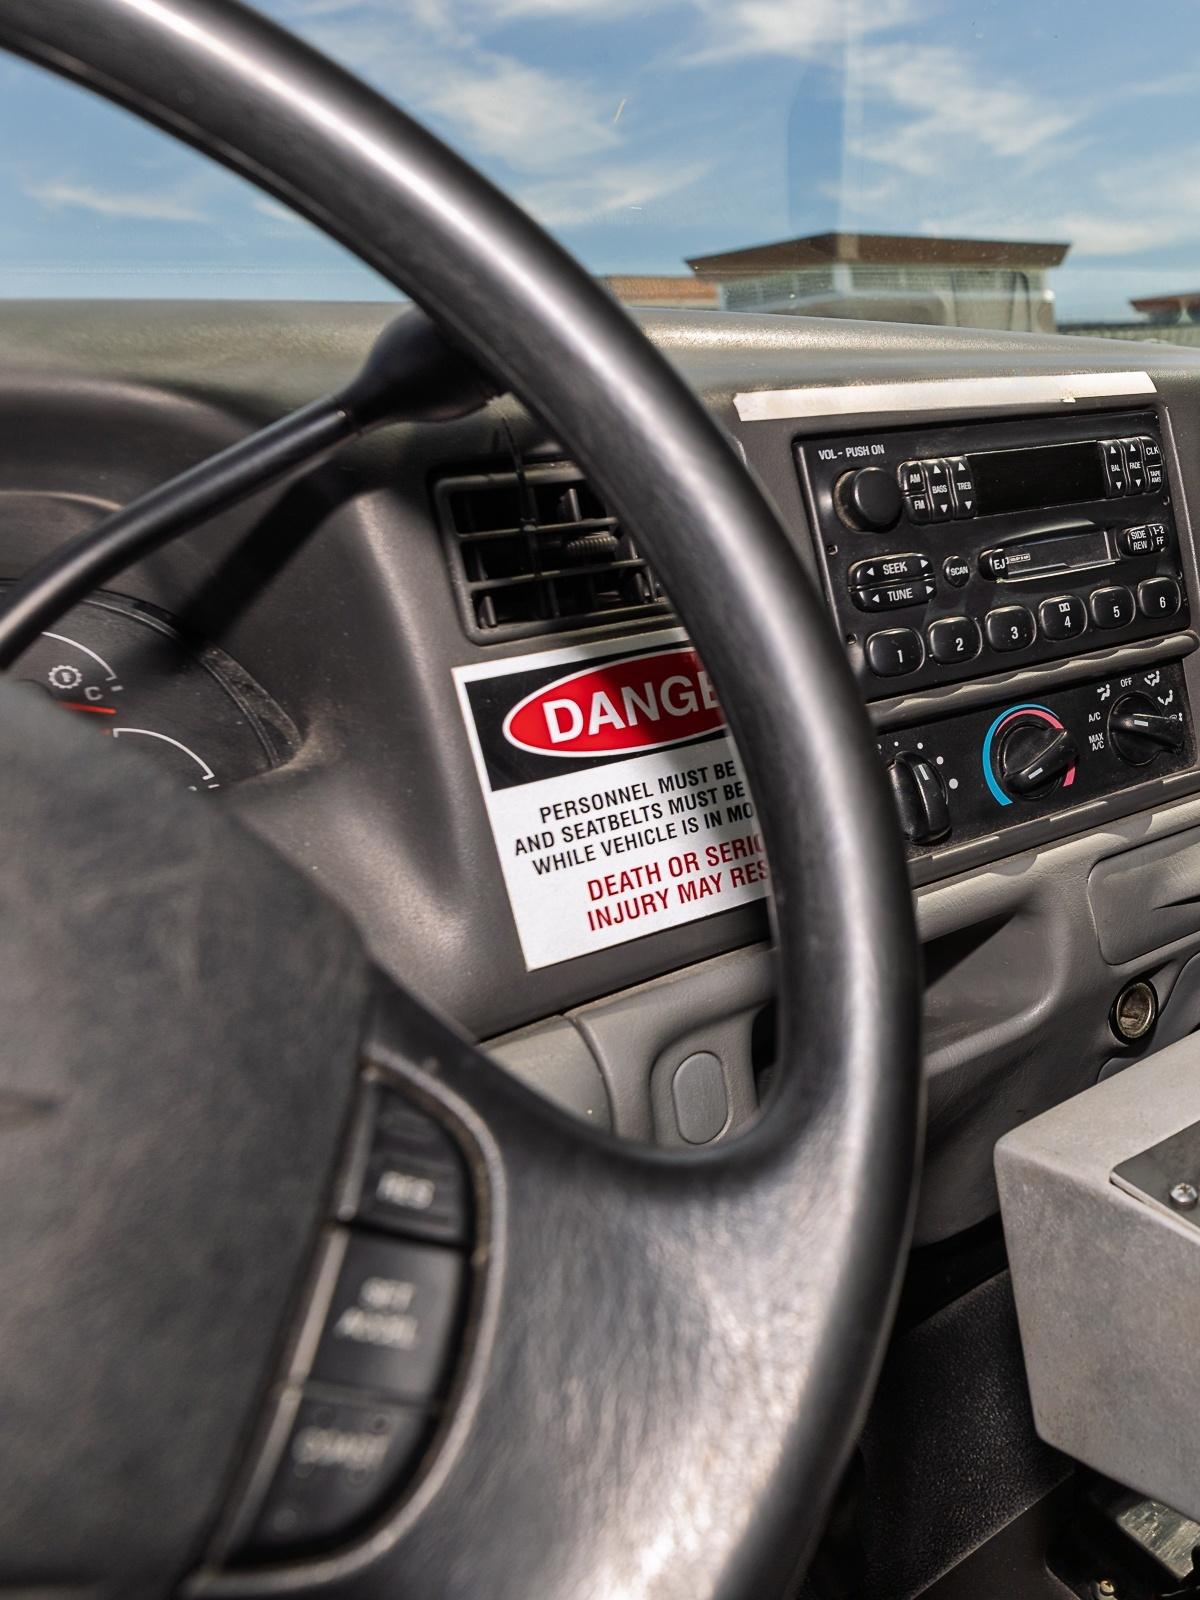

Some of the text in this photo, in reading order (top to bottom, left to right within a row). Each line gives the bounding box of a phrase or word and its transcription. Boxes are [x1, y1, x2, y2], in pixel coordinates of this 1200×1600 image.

[846, 446, 870, 458] PUSH
[871, 444, 885, 454] ON
[1145, 446, 1160, 456] CLK
[1111, 464, 1121, 472] BAL
[1129, 462, 1141, 470] FADE
[909, 473, 921, 484] AM
[932, 484, 948, 494] BASS
[957, 481, 972, 491] TREB
[914, 499, 925, 510] FM
[1130, 530, 1147, 540] SIDE
[1153, 525, 1165, 536] 1-2
[1133, 540, 1148, 551] REW
[1156, 536, 1164, 546] FF
[882, 562, 908, 575] SEEK
[950, 566, 969, 577] SCAN
[887, 588, 914, 602] TUNE
[1159, 596, 1166, 609] 6
[1113, 605, 1121, 618] 5
[1064, 615, 1072, 628] 4
[1010, 626, 1019, 640] 3
[955, 637, 964, 652] 2
[897, 649, 904, 663] 1
[1120, 677, 1133, 688] OFF
[541, 671, 722, 744] DANGE
[1088, 711, 1101, 723] A/C
[1088, 732, 1104, 744] MAX
[1092, 741, 1105, 751] A/C
[540, 760, 737, 824] PERSONNEL MUST BE
[514, 782, 745, 856] AND SEATBELTS MUST BE
[532, 845, 596, 876] WHILE
[600, 823, 678, 857] VEHICLE
[682, 817, 699, 835] IS
[704, 811, 723, 829] IN
[587, 863, 662, 902] DEATH
[668, 851, 700, 878] OR
[587, 888, 670, 931] INJURY
[677, 872, 722, 905] MAY
